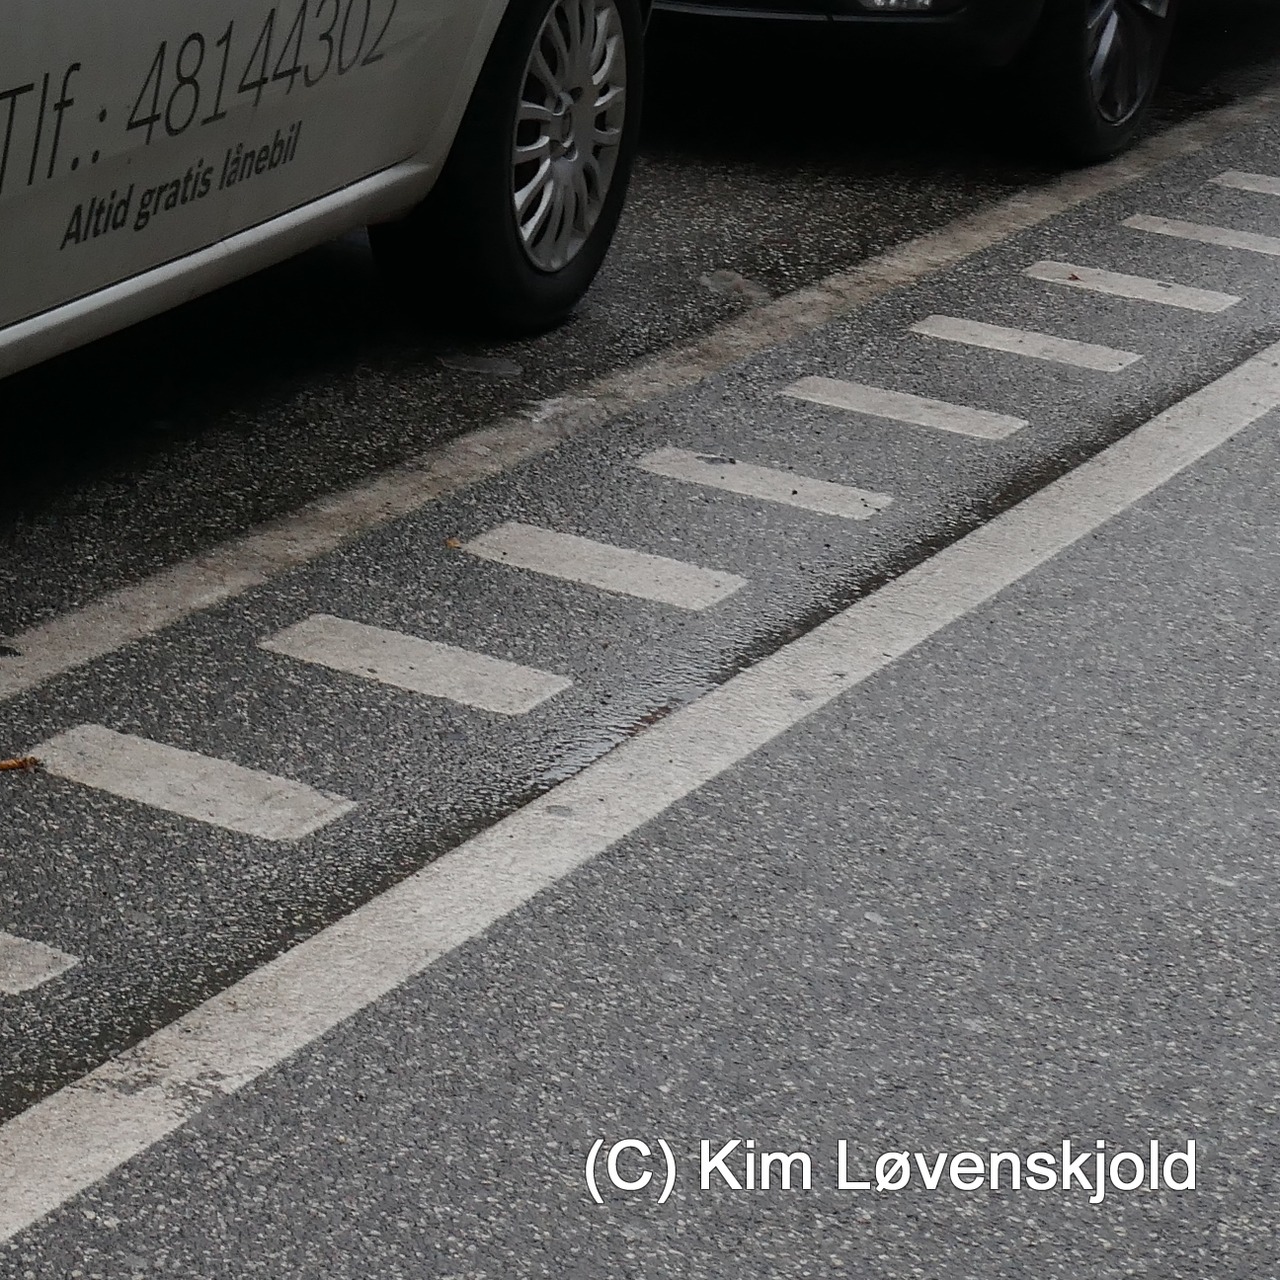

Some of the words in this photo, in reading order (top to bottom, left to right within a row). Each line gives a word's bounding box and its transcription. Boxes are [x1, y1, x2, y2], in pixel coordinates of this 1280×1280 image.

[59, 186, 132, 251] Altid
[134, 164, 213, 232] gratis
[218, 120, 302, 191] lånebil
